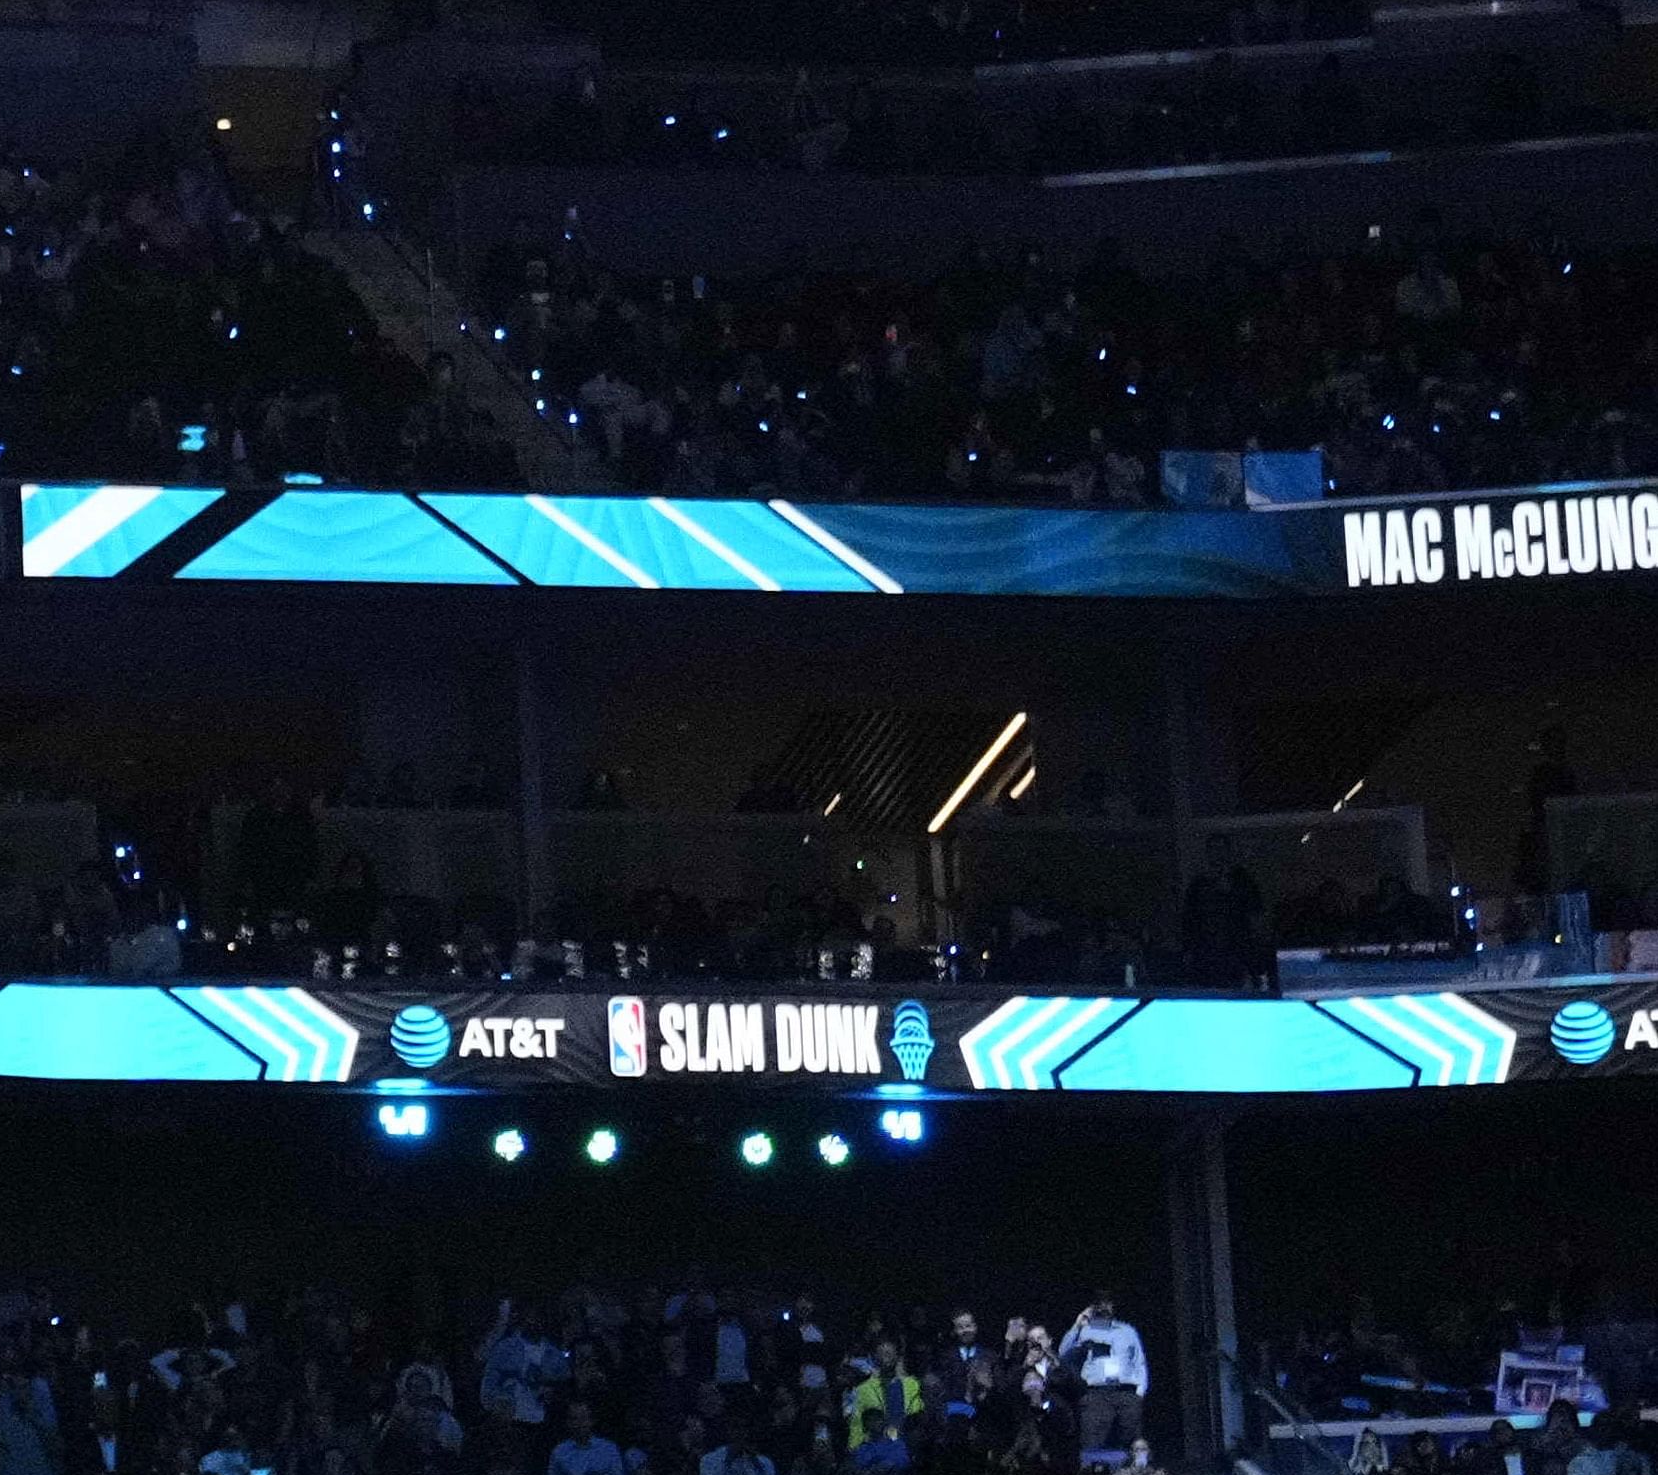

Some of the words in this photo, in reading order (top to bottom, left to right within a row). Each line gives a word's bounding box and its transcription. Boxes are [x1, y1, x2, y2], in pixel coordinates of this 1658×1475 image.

[1344, 508, 1445, 588] MAC
[459, 1013, 565, 1059] AT&T
[658, 1001, 768, 1074] SLAM
[776, 1003, 882, 1075] DUNK
